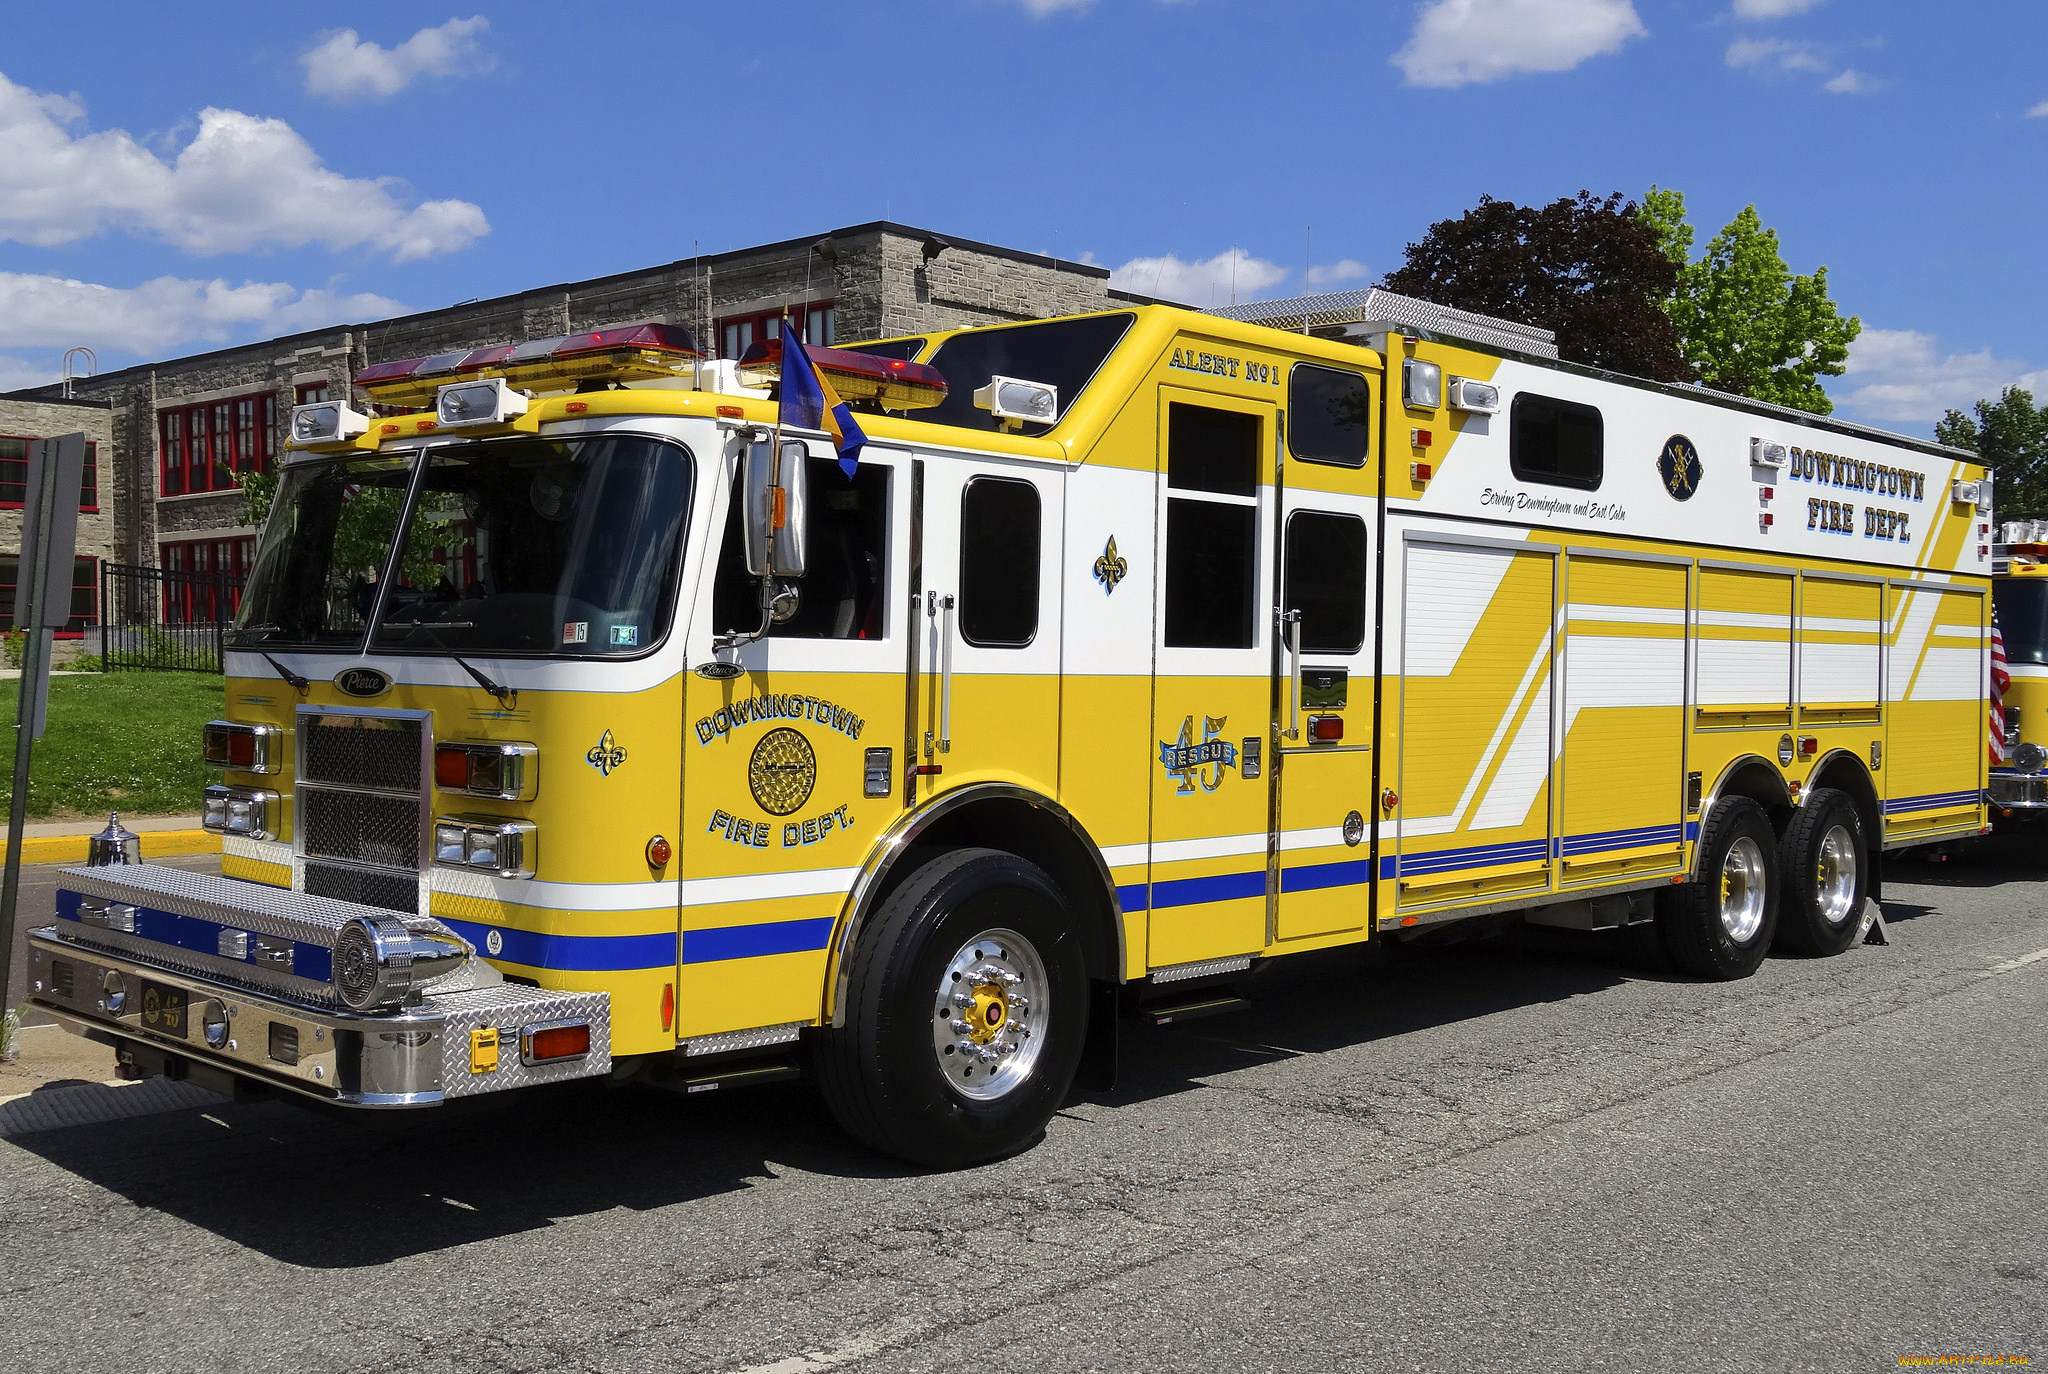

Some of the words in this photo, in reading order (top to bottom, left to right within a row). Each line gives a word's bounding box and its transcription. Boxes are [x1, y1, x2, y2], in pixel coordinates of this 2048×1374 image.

[1168, 347, 1240, 378] ALERT
[1790, 446, 1926, 503] DOWNINGTOWN
[1480, 488, 1515, 513] Serving
[1516, 492, 1571, 518] Downingtown
[1573, 500, 1589, 516] and
[1589, 503, 1608, 518] East
[1807, 497, 1854, 536] FIRE
[1864, 506, 1911, 544] DEPT.
[577, 624, 585, 640] 15
[346, 671, 379, 690] Pierce
[703, 664, 735, 674] Lance
[695, 693, 866, 748] DOWNINGTOWN
[1165, 743, 1233, 767] RESCUE
[1167, 714, 1228, 796] 45
[707, 808, 772, 849] FIRE
[782, 803, 855, 849] DEPT.
